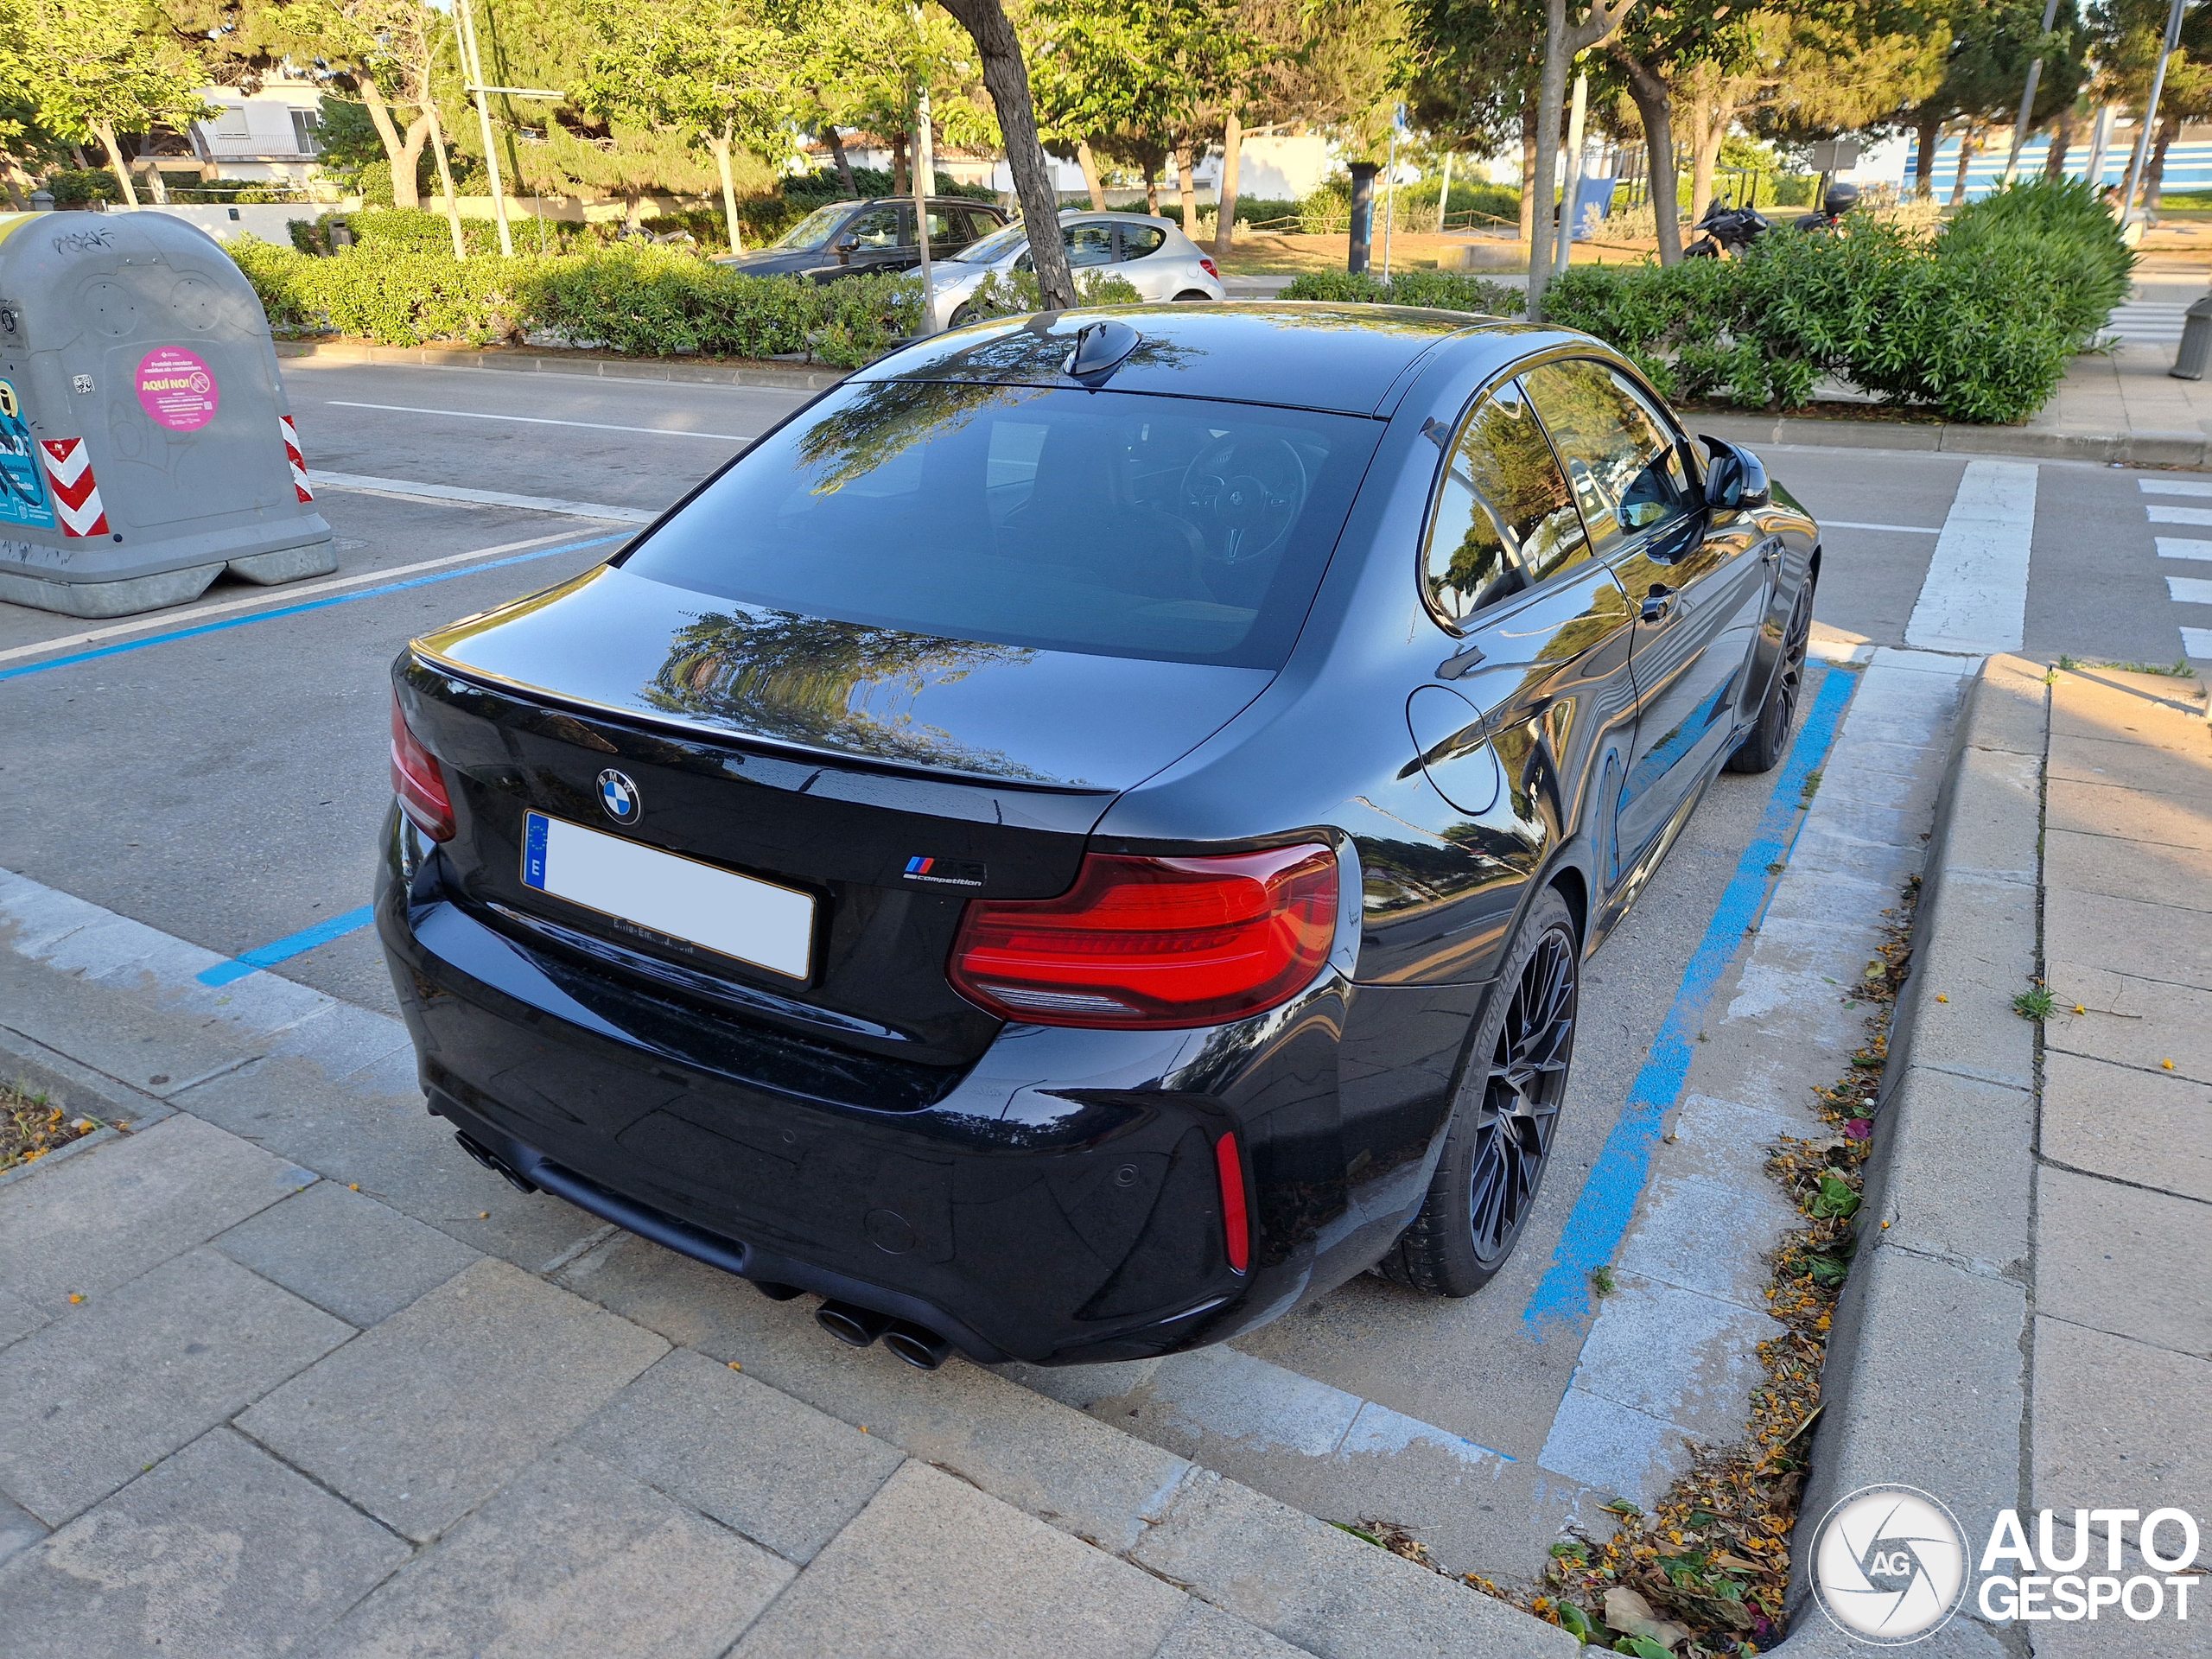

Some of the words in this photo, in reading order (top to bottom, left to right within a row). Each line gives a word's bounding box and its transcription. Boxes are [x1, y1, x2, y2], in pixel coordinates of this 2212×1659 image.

[143, 378, 169, 391] AQUÍ
[170, 378, 189, 389] NO!
[599, 772, 633, 793] BMW
[532, 859, 540, 875] E
[917, 874, 982, 887] competition
[1478, 956, 1516, 1062] MICHELIN
